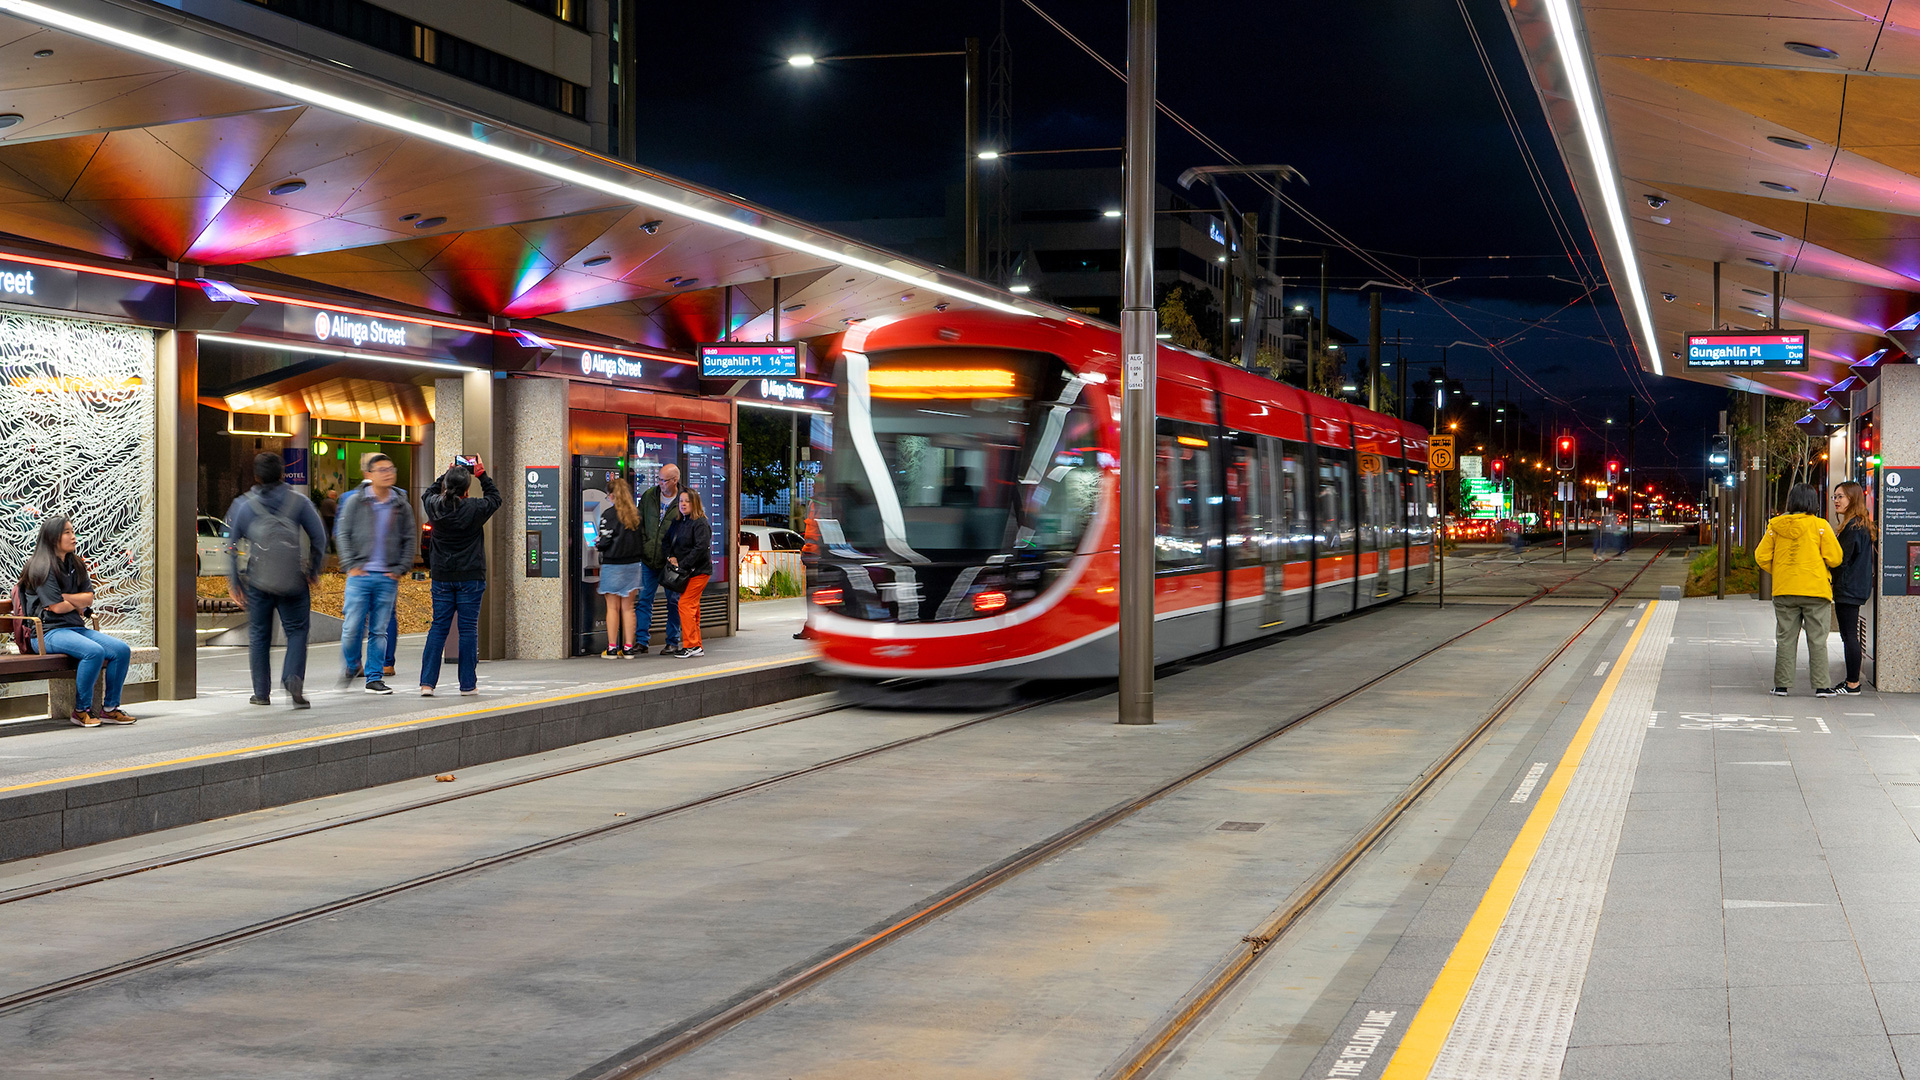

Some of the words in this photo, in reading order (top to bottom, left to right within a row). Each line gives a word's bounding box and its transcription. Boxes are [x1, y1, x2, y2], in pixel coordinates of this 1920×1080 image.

[331, 315, 368, 346] Alinga
[370, 319, 406, 346] Street
[703, 356, 750, 368] Gungahlin
[752, 356, 762, 366] Pl
[769, 356, 781, 366] 14
[1690, 346, 1747, 360] Gungahlin
[1749, 346, 1761, 357] Pl
[592, 353, 616, 378] Alinga
[616, 358, 642, 377] Street
[768, 380, 787, 400] Alinga
[787, 383, 805, 400] Street
[1436, 453, 1446, 464] 15
[1360, 1010, 1397, 1028] LINE
[1340, 1026, 1386, 1058] YELLOW
[1328, 1059, 1367, 1077] THE
